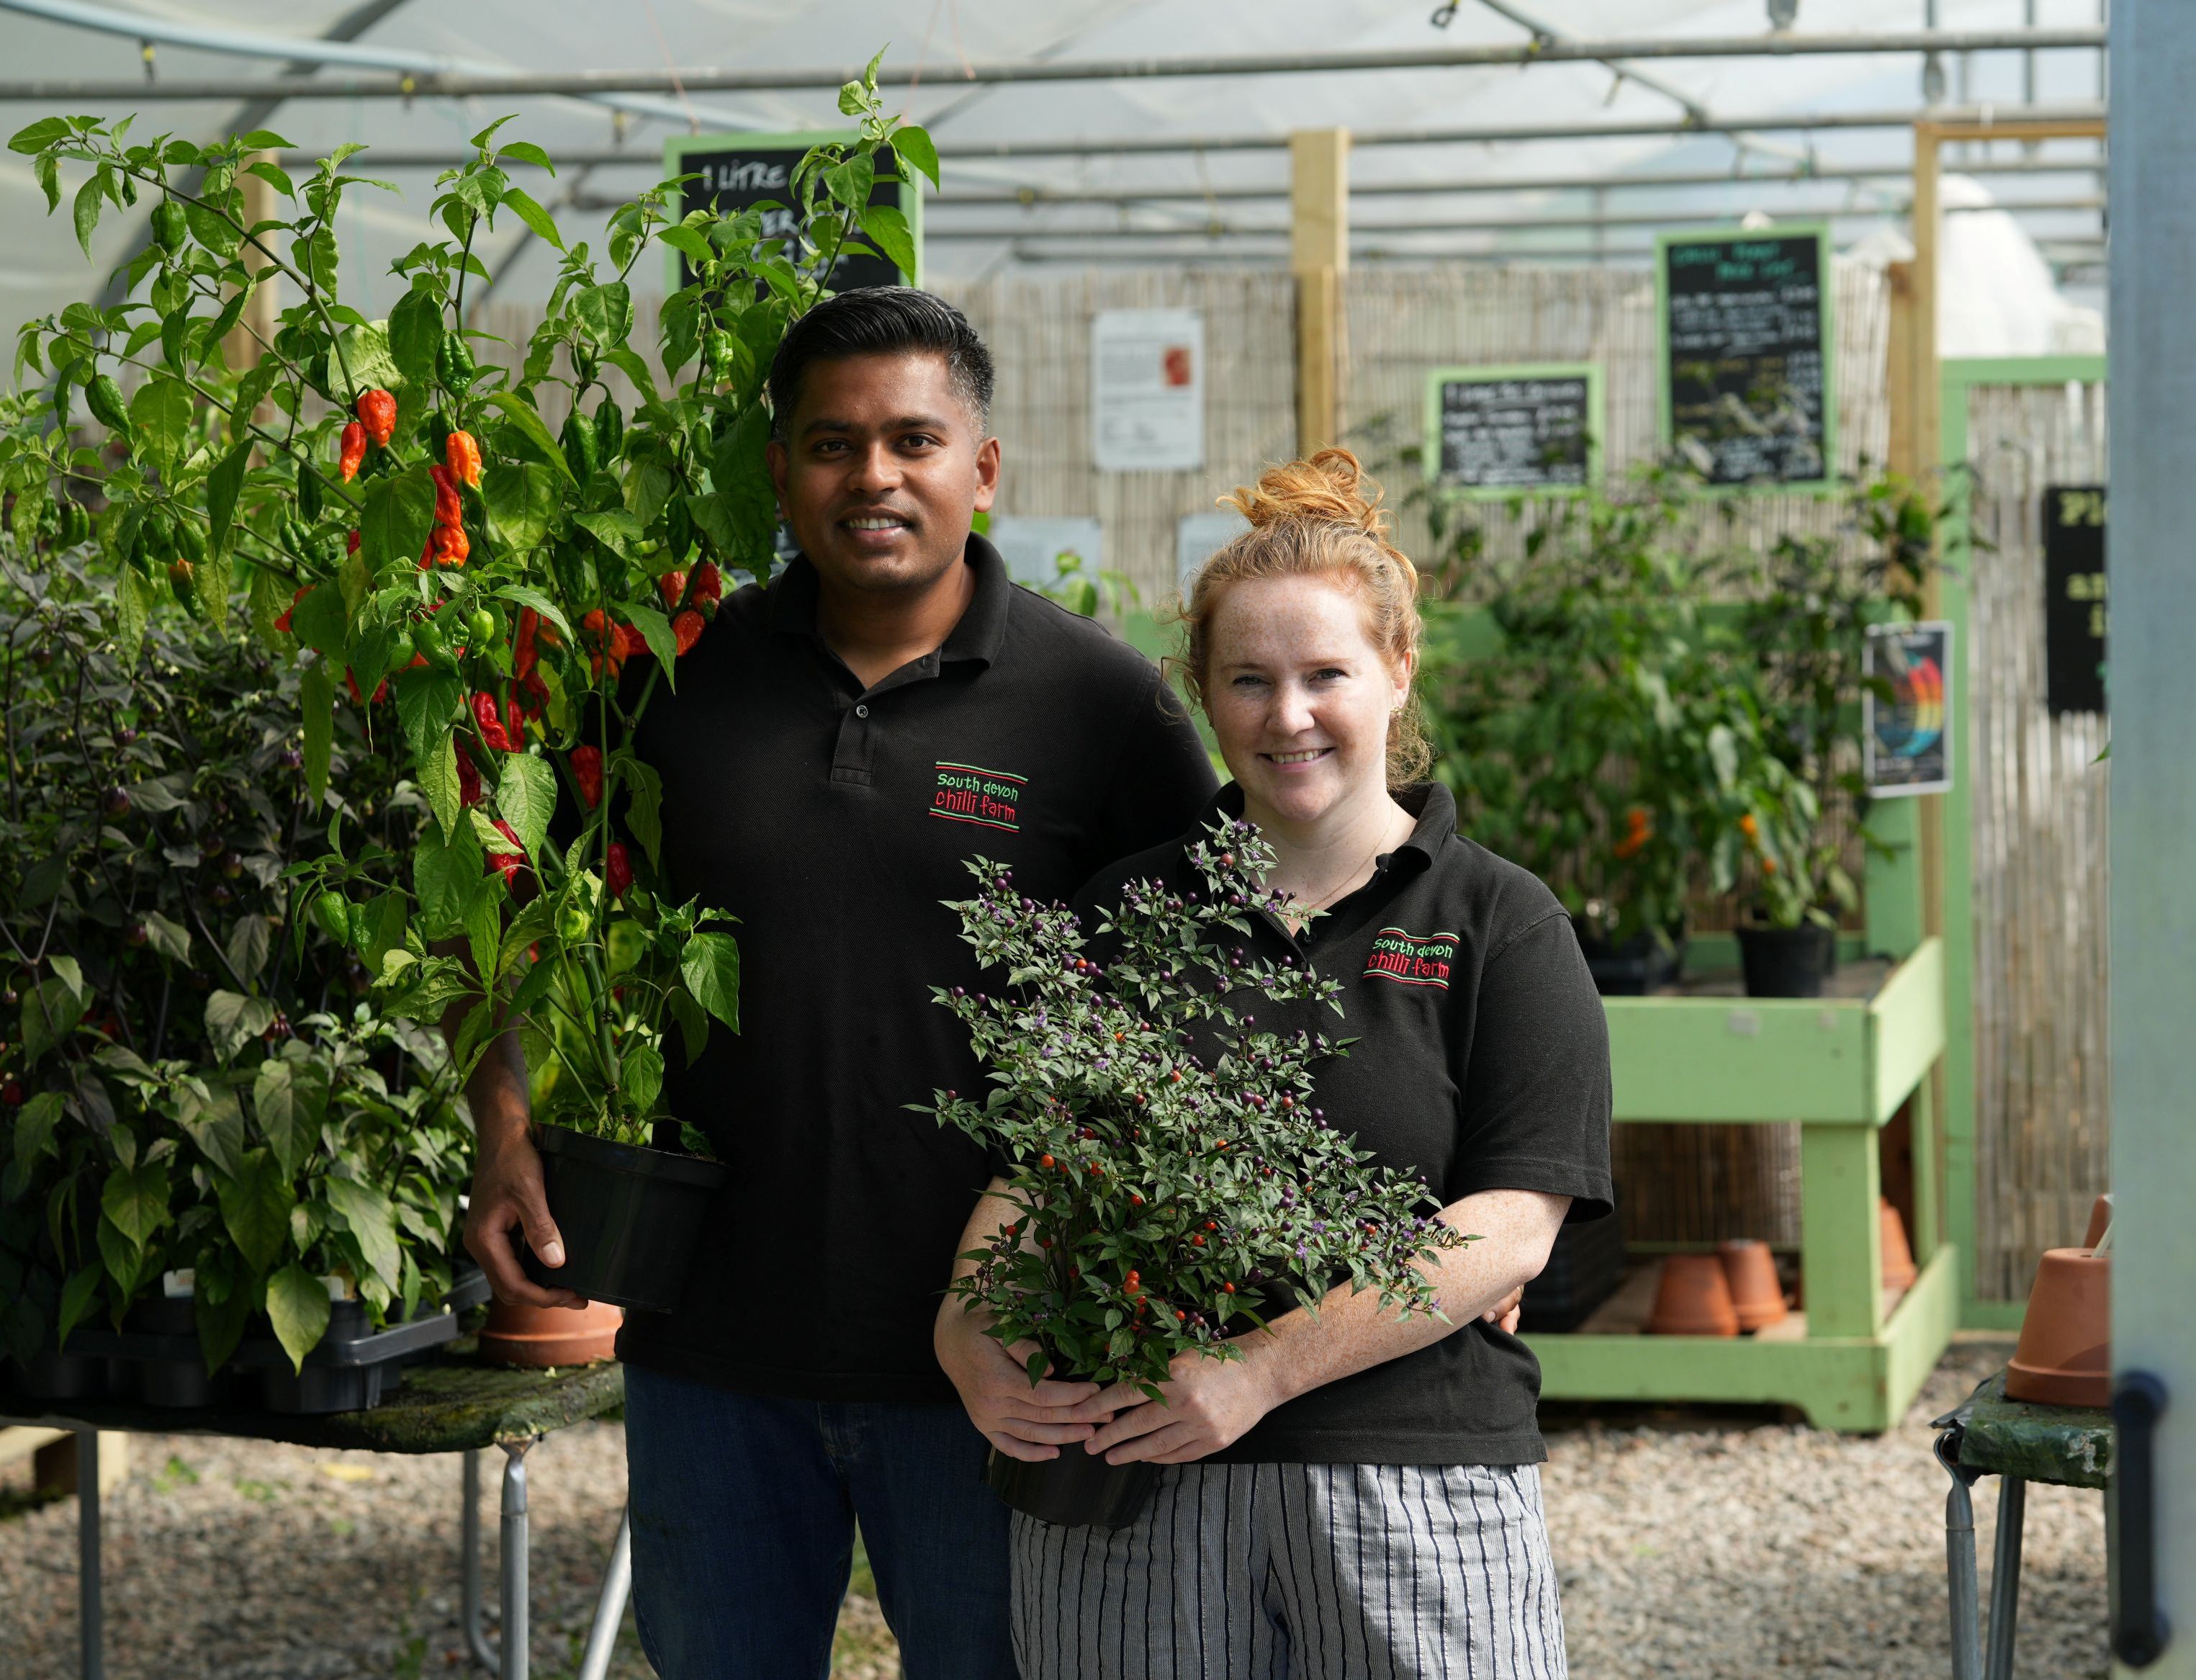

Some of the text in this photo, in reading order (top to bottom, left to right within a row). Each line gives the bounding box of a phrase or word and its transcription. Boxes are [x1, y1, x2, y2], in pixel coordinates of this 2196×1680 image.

[984, 781, 1019, 801] devon
[936, 789, 1016, 822] chilli farm
[1417, 945, 1453, 959] devon
[1368, 951, 1449, 979] chilli farm
